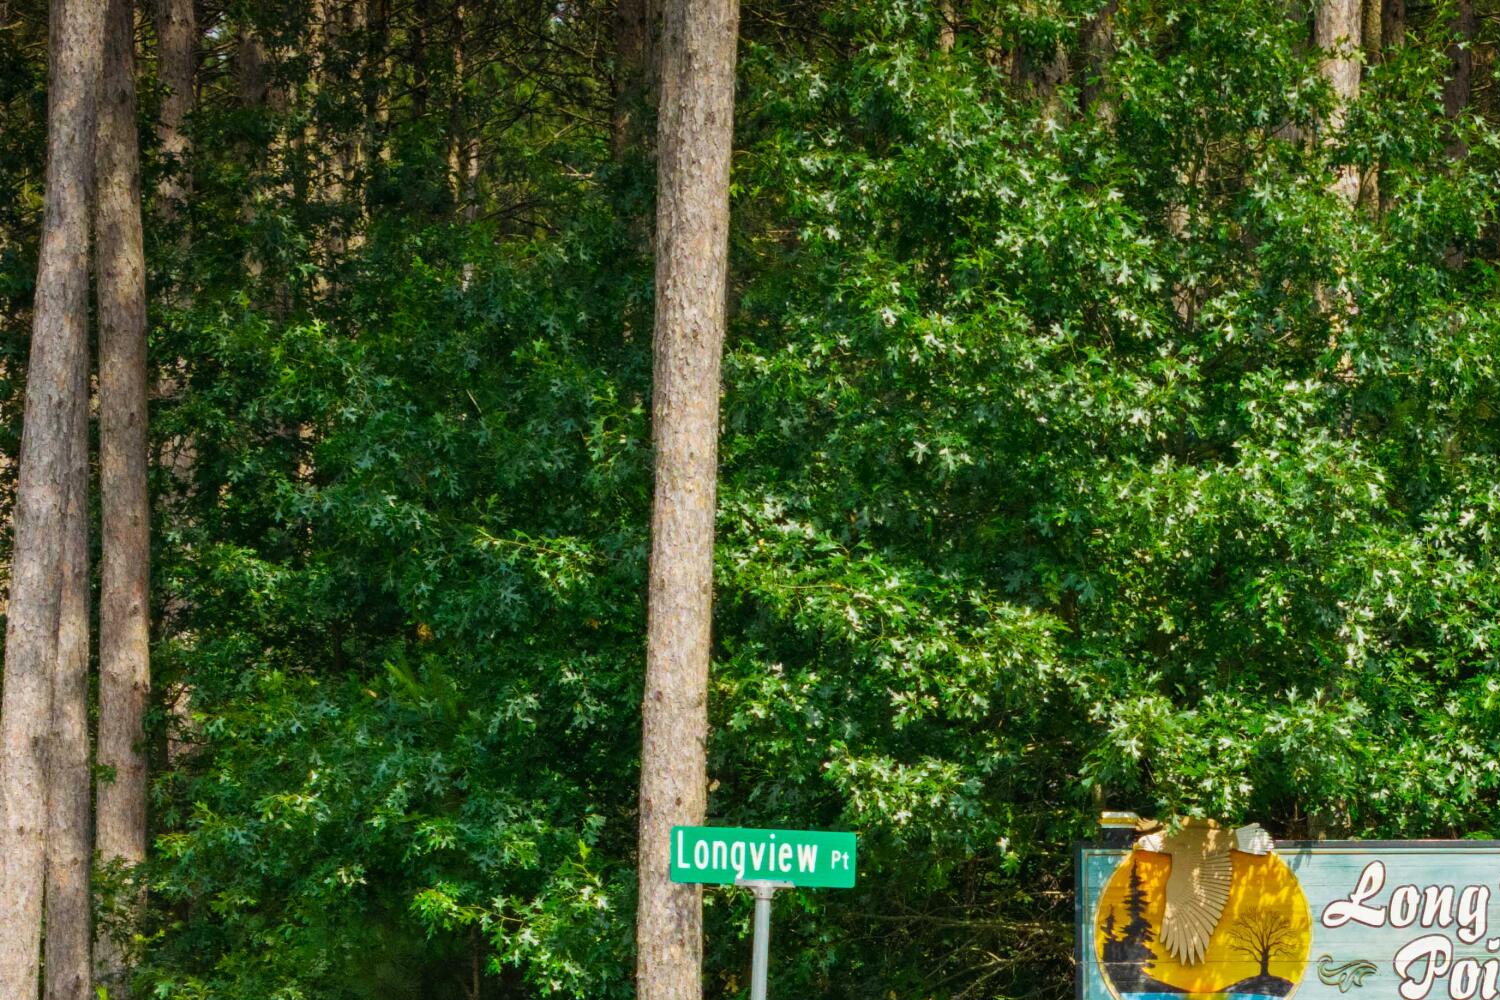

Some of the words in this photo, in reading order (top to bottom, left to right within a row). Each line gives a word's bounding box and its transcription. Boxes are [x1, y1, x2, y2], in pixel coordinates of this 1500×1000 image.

[677, 829, 818, 880] Longview
[831, 850, 850, 870] Pt
[1321, 860, 1491, 944] Long
